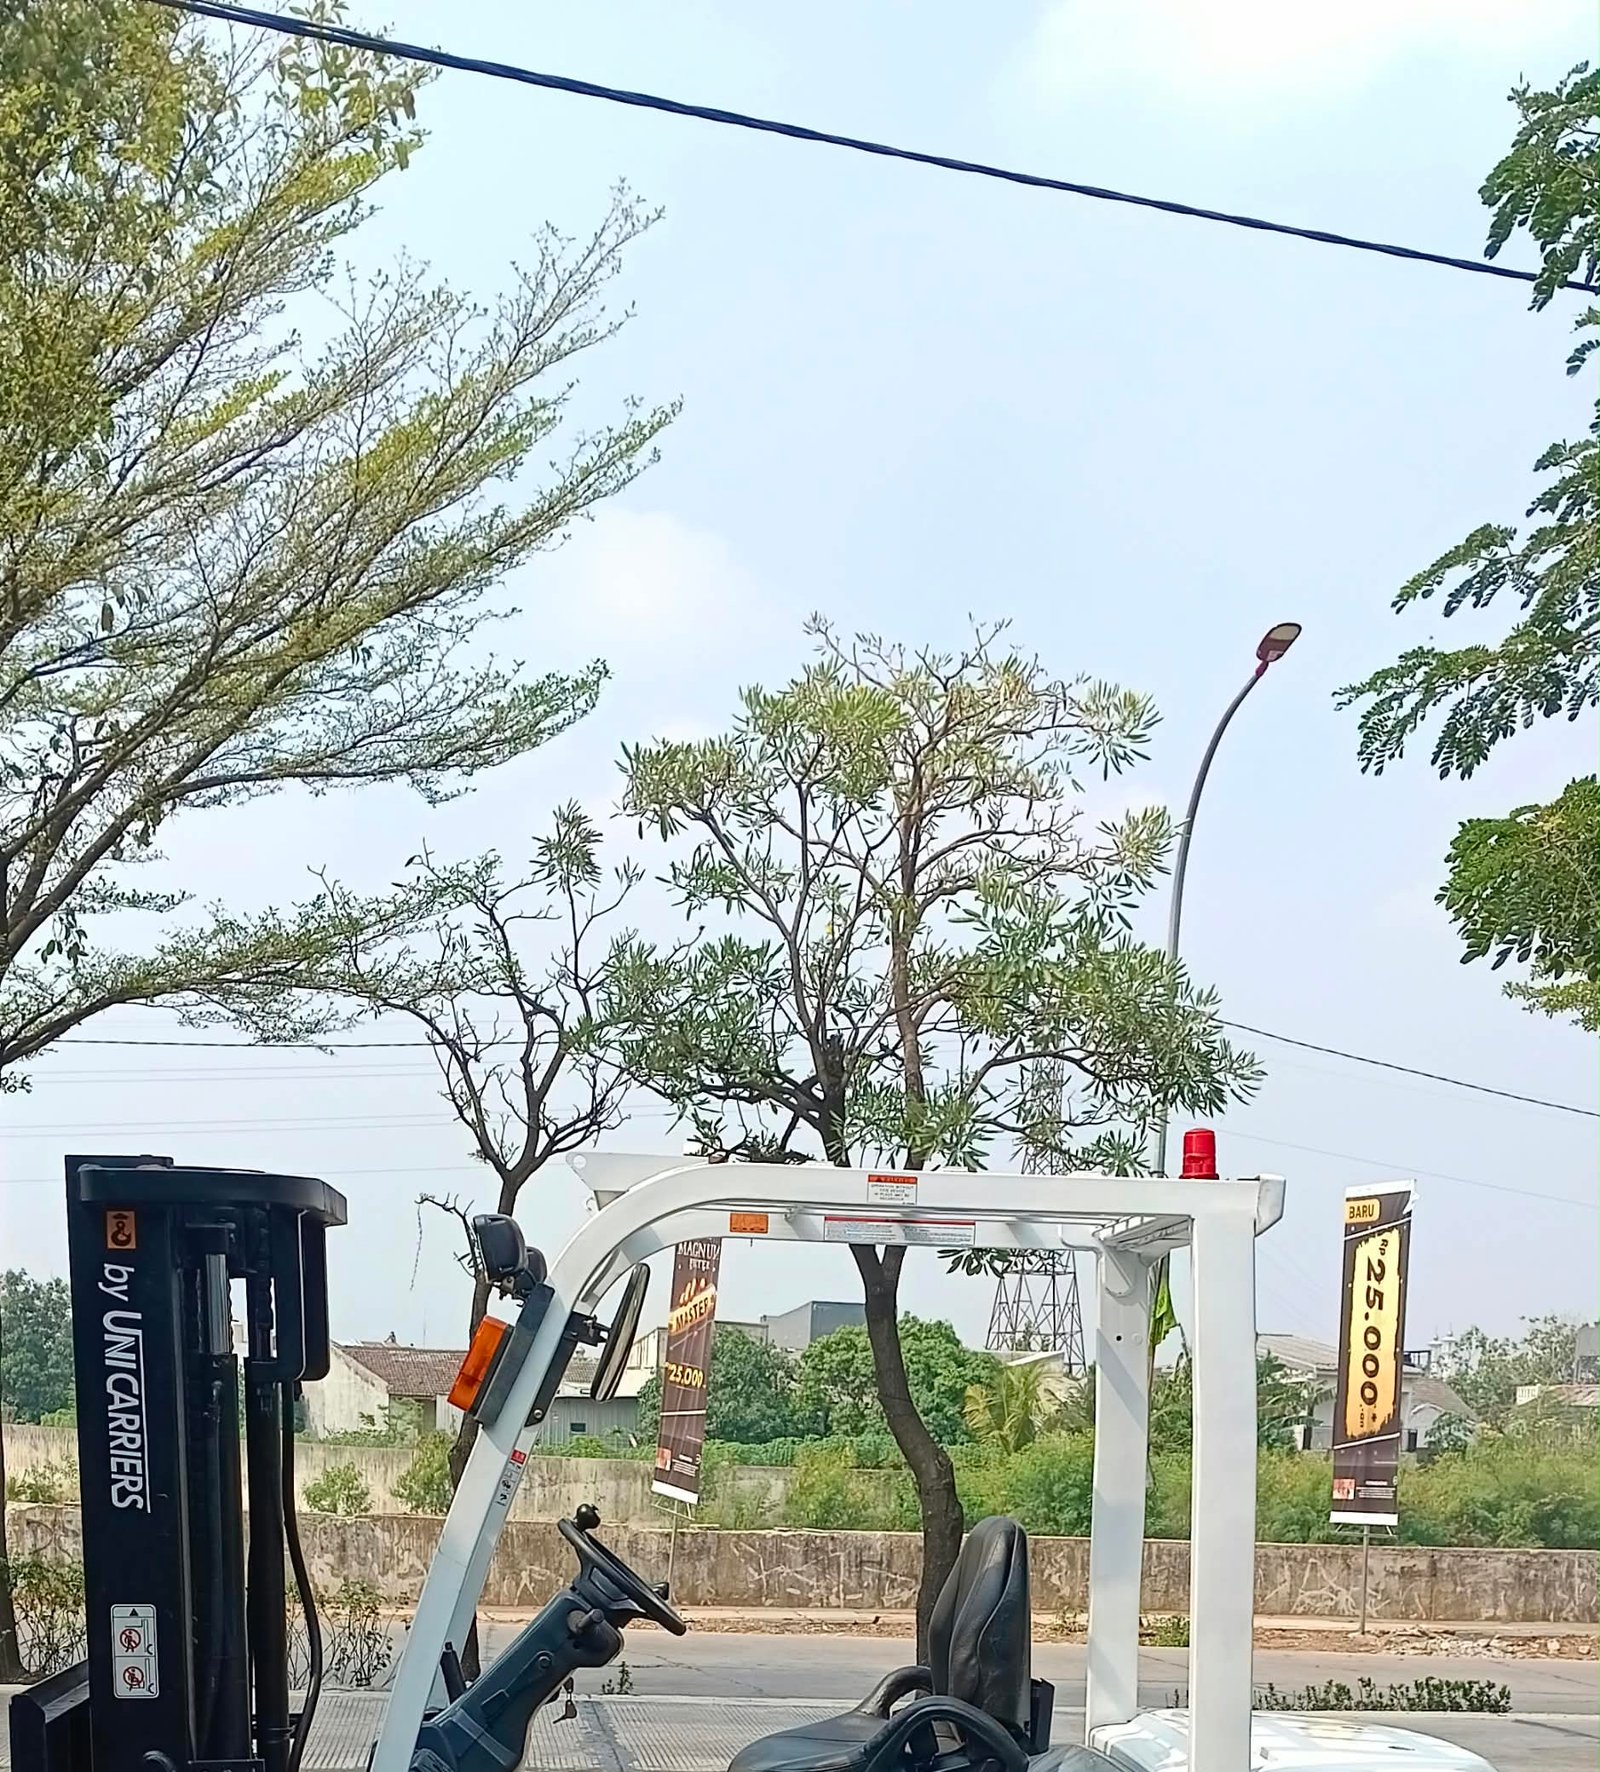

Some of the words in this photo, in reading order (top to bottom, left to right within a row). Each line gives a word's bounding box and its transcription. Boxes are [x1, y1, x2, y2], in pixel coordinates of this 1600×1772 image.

[1349, 1204, 1375, 1219] BARU
[98, 1263, 135, 1302] by
[676, 1296, 709, 1331] MASTER
[1360, 1256, 1386, 1406] 25.000
